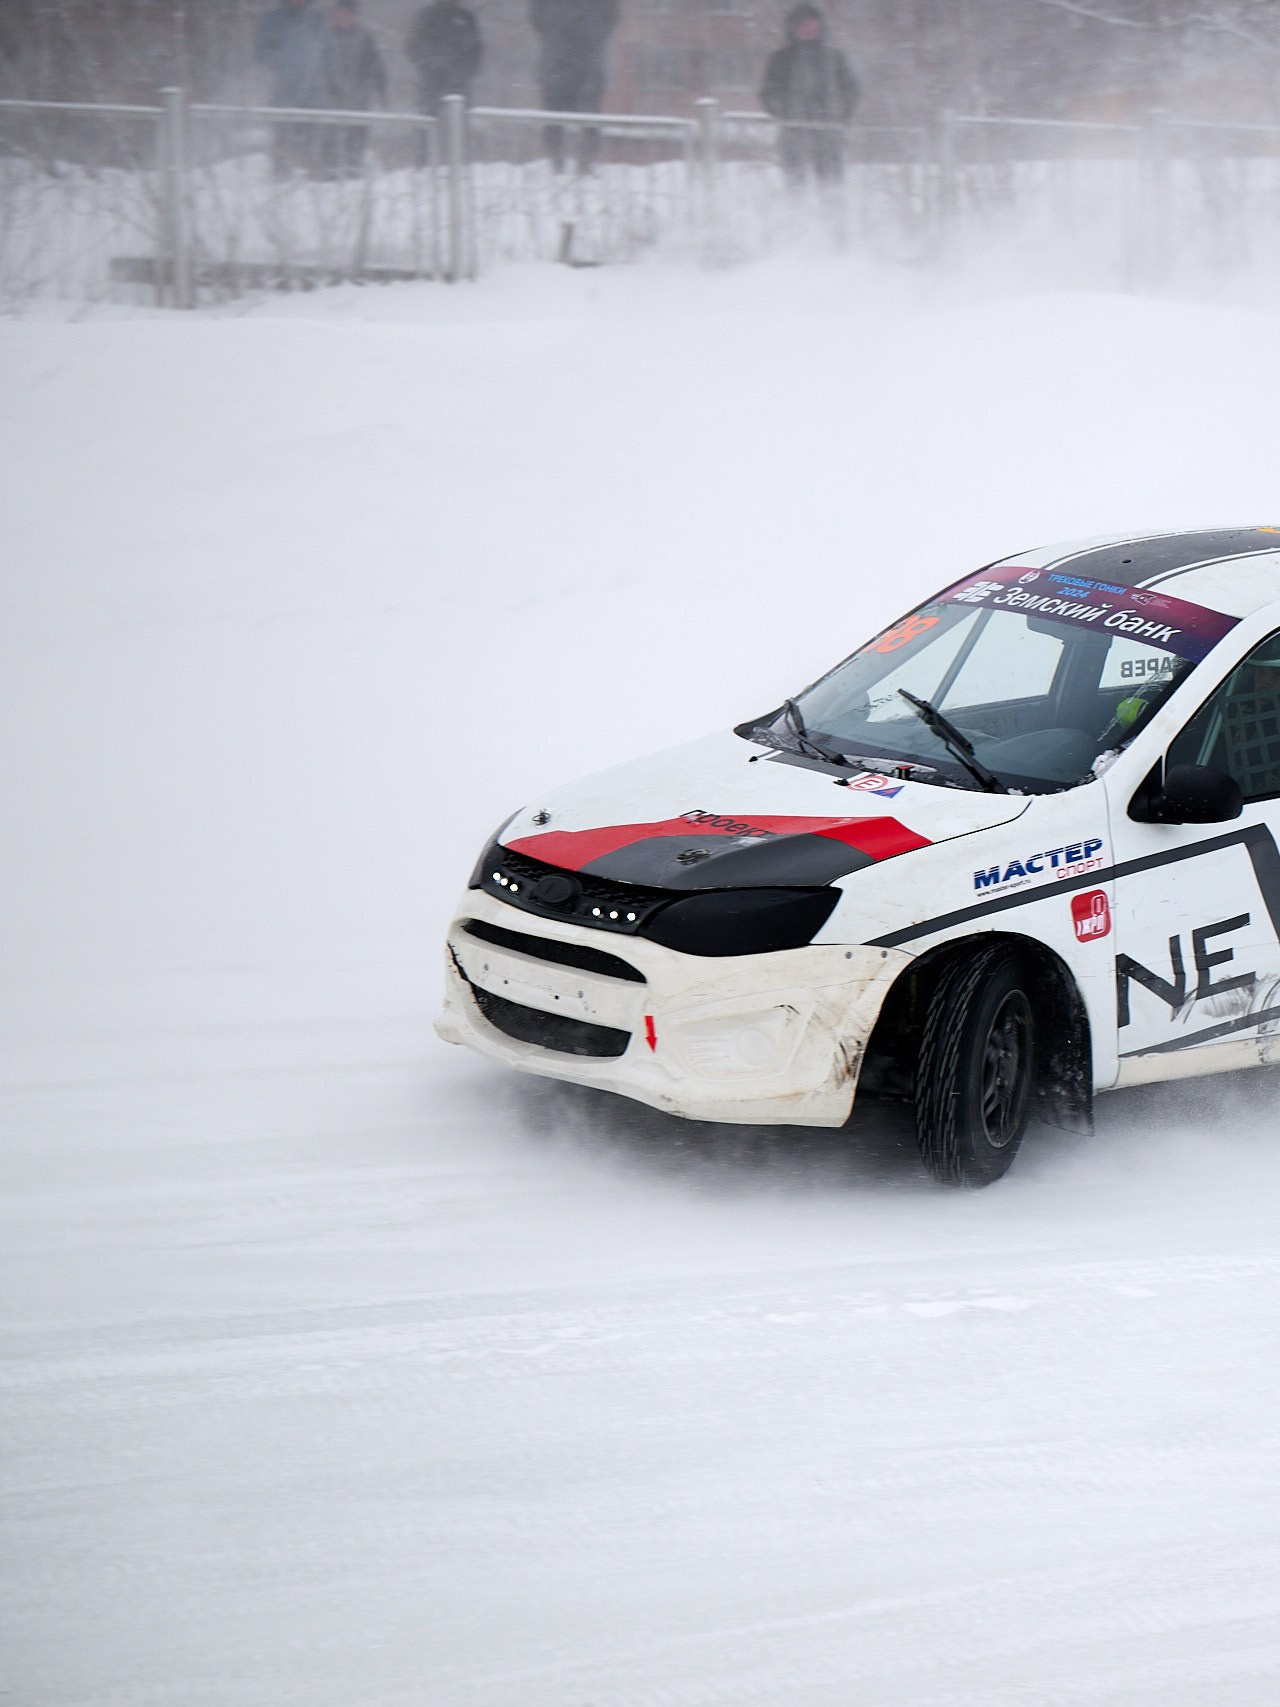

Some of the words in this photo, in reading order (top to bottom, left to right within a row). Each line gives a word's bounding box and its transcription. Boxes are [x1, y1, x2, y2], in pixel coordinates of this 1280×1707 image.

[1047, 573, 1095, 589] ТРЕКОВЫЕ
[1093, 582, 1128, 595] ГОНКИ
[1056, 587, 1091, 599] 2024
[993, 586, 1112, 622] Земский
[1103, 609, 1182, 643] банк
[973, 837, 1103, 890] МАСТЕР
[1056, 857, 1104, 879] СПОРТ
